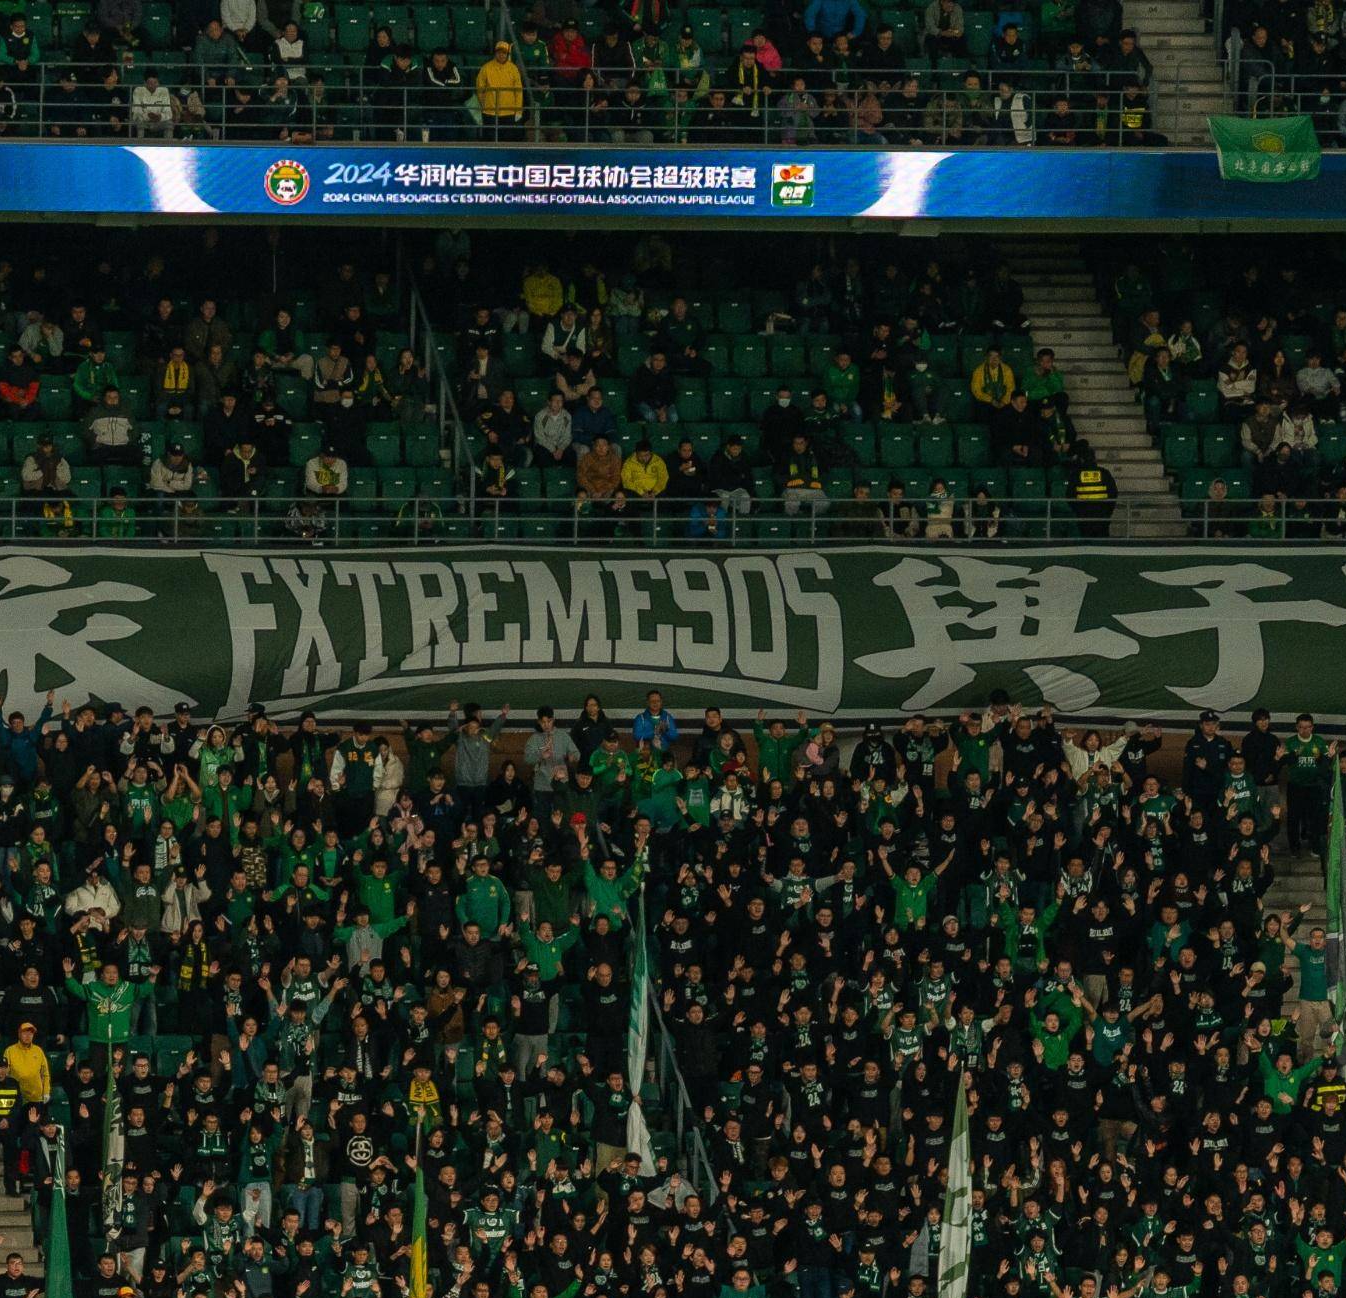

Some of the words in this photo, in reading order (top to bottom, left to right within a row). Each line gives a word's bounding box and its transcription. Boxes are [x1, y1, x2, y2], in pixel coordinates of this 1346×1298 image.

[323, 193, 351, 203] 2024
[352, 193, 385, 203] CHINA
[386, 193, 450, 204] RESOURCES
[504, 194, 549, 204] CHINESE
[550, 194, 605, 205] FOOTBALL
[606, 194, 677, 205] ASSOCIATION
[678, 194, 713, 205] SUPER
[714, 194, 755, 205] LEAGUE
[200, 551, 844, 722] EXTREME90S
